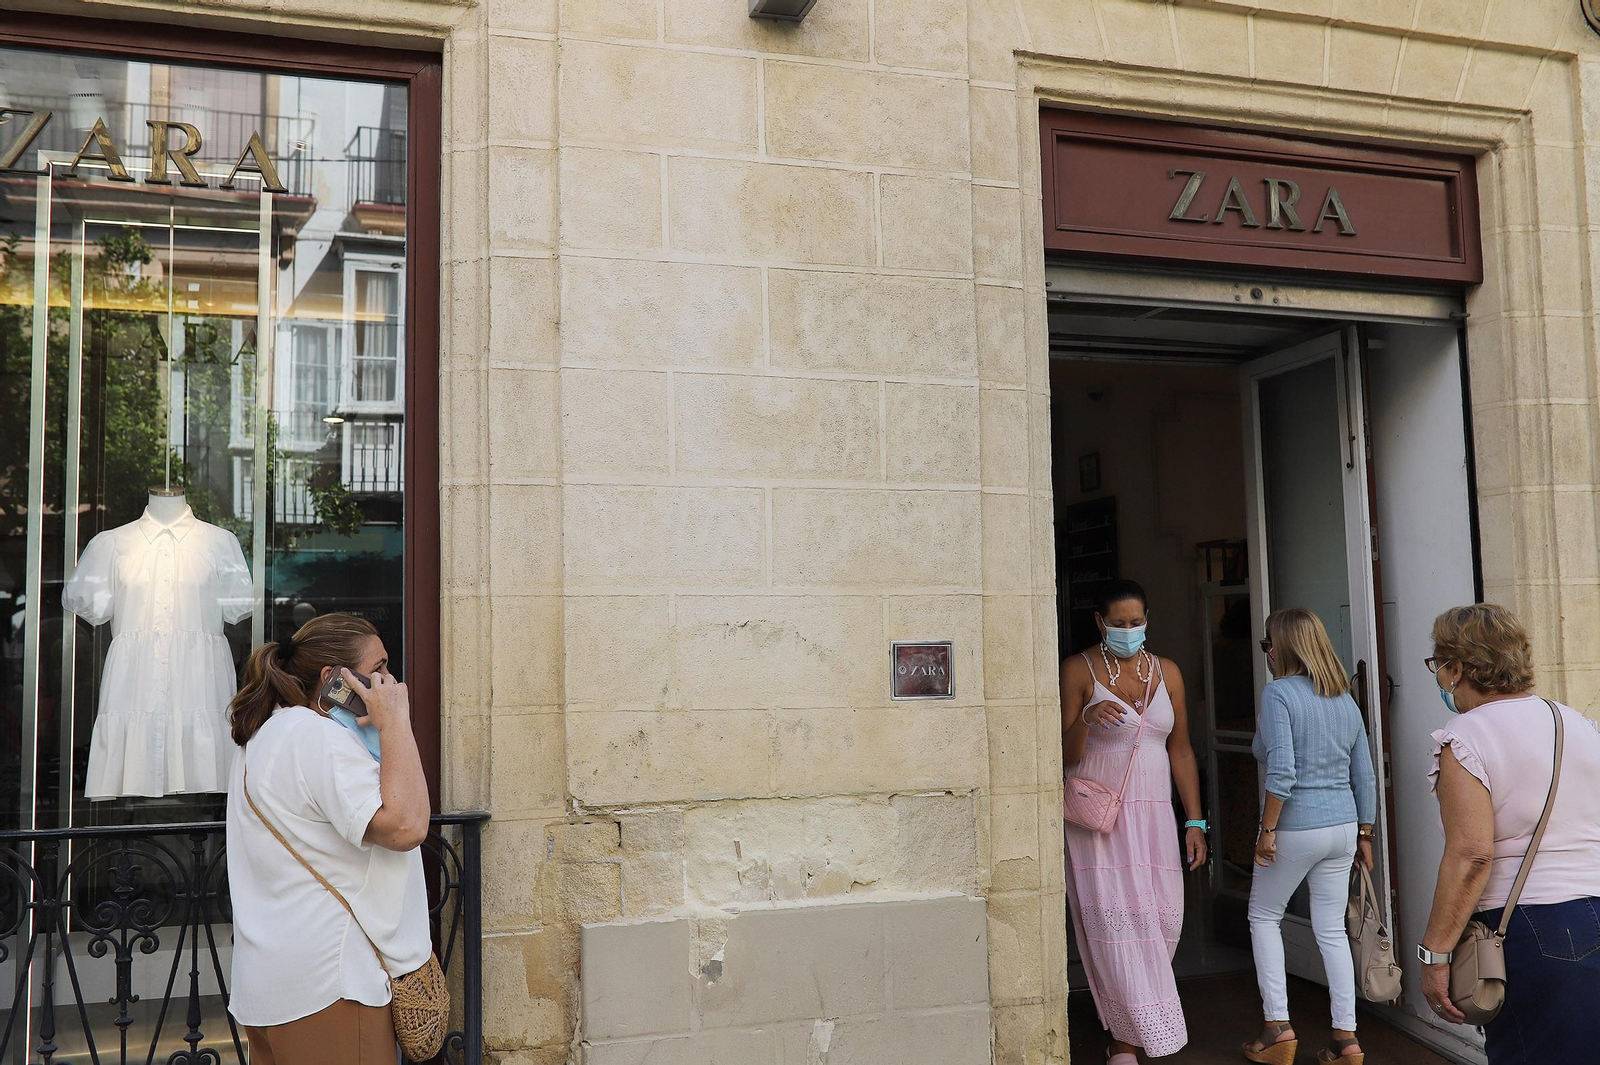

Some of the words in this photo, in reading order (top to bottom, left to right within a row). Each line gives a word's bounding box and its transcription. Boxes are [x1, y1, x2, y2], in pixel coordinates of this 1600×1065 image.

[0, 107, 289, 193] ZARA
[1167, 168, 1357, 236] ZARA
[910, 665, 945, 676] ZARA
